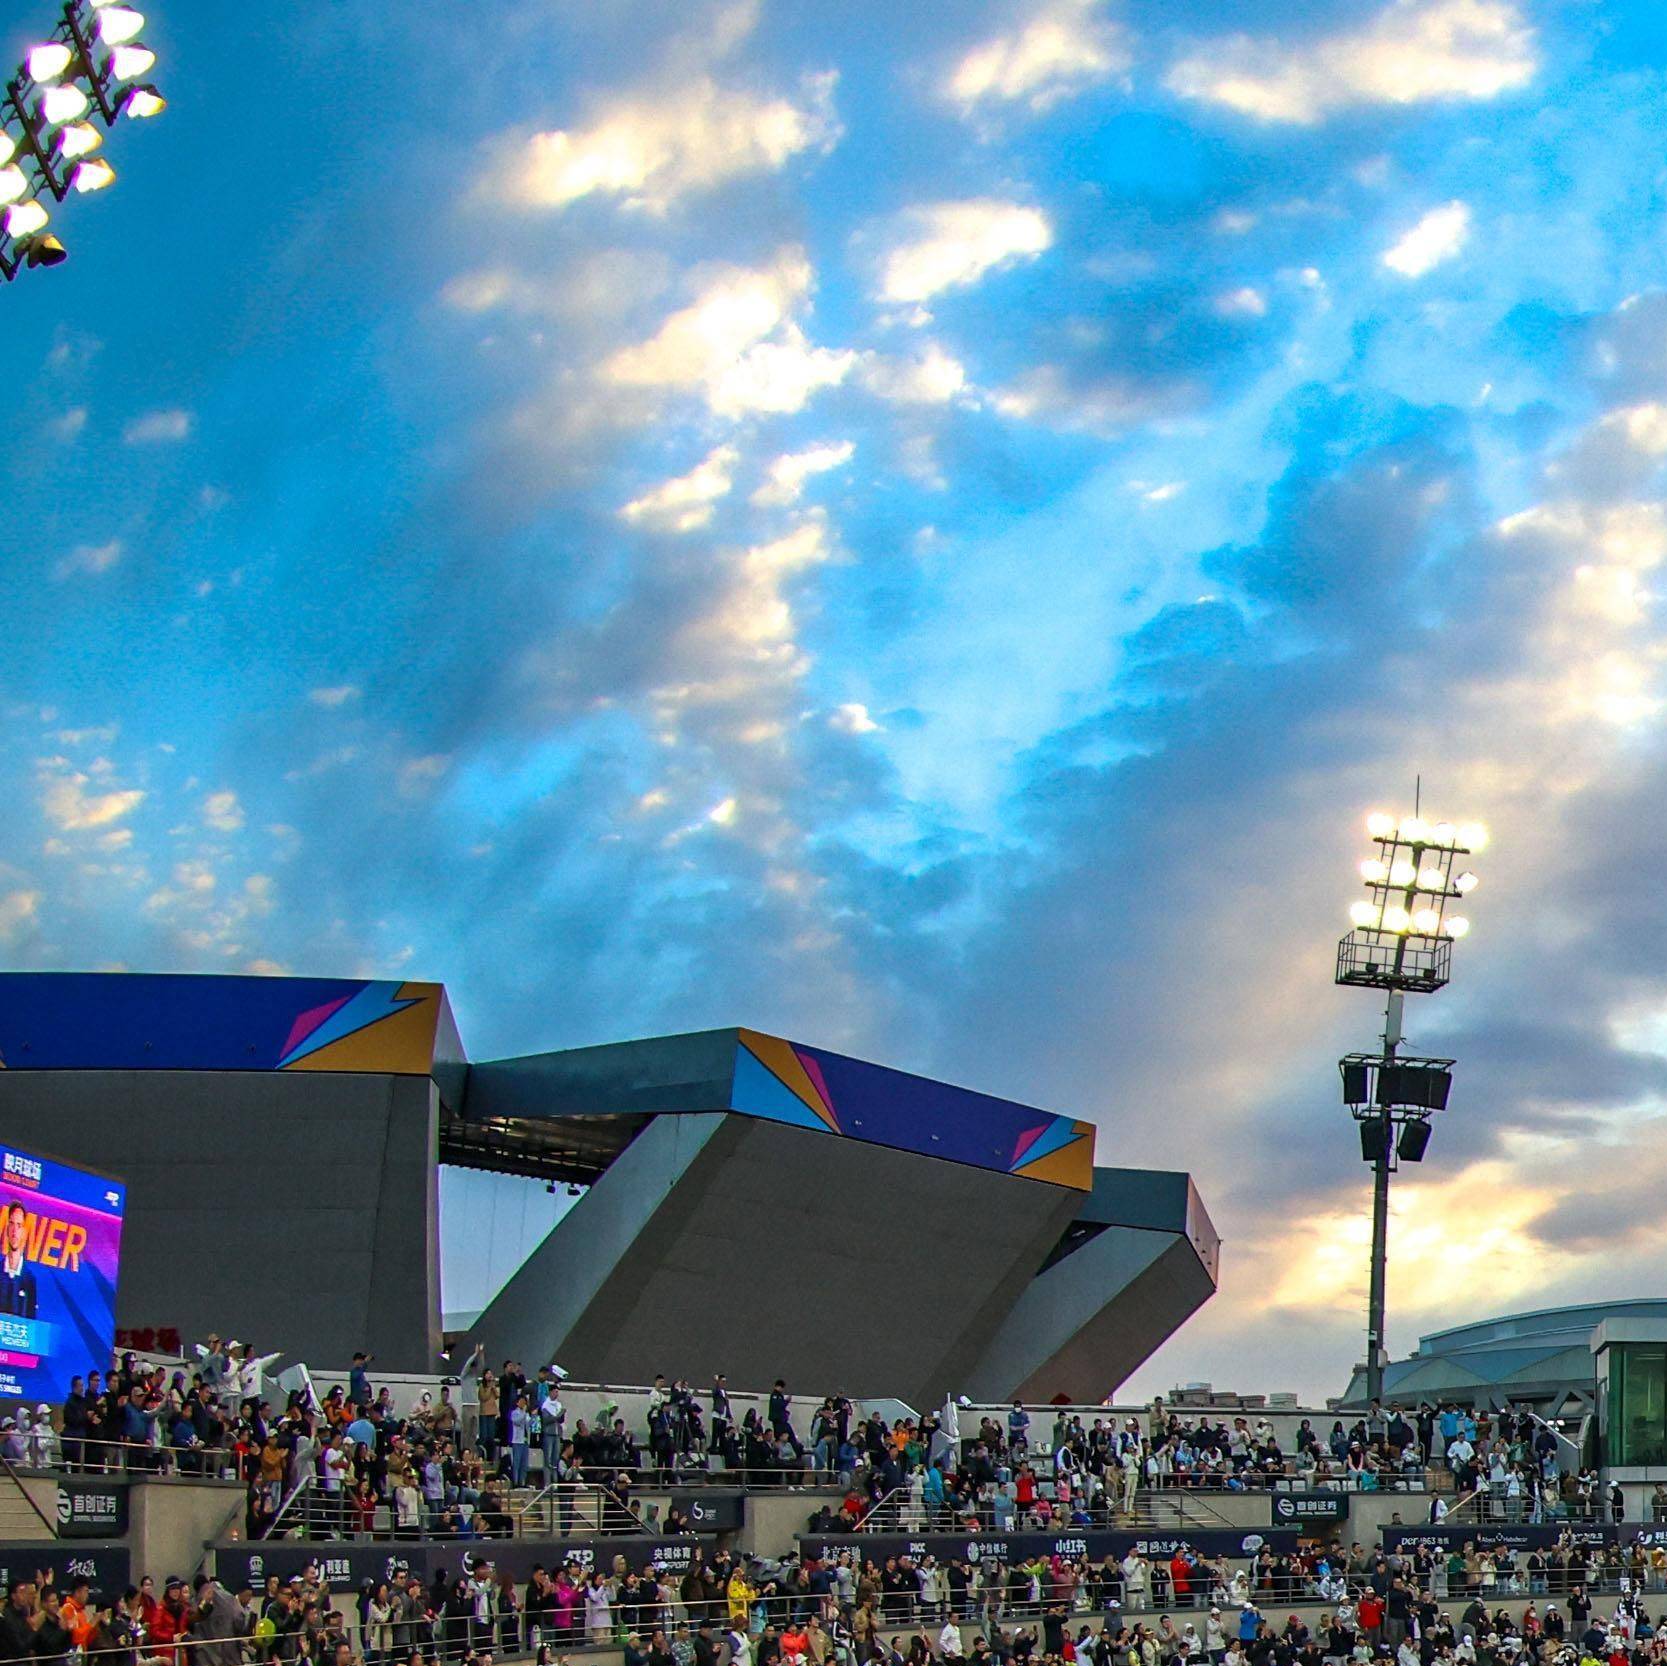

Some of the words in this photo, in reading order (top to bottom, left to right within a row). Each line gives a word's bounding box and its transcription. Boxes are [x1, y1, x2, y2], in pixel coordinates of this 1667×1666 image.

[1056, 1540, 1086, 1553] 小红书
[654, 1547, 691, 1561] 央视体育
